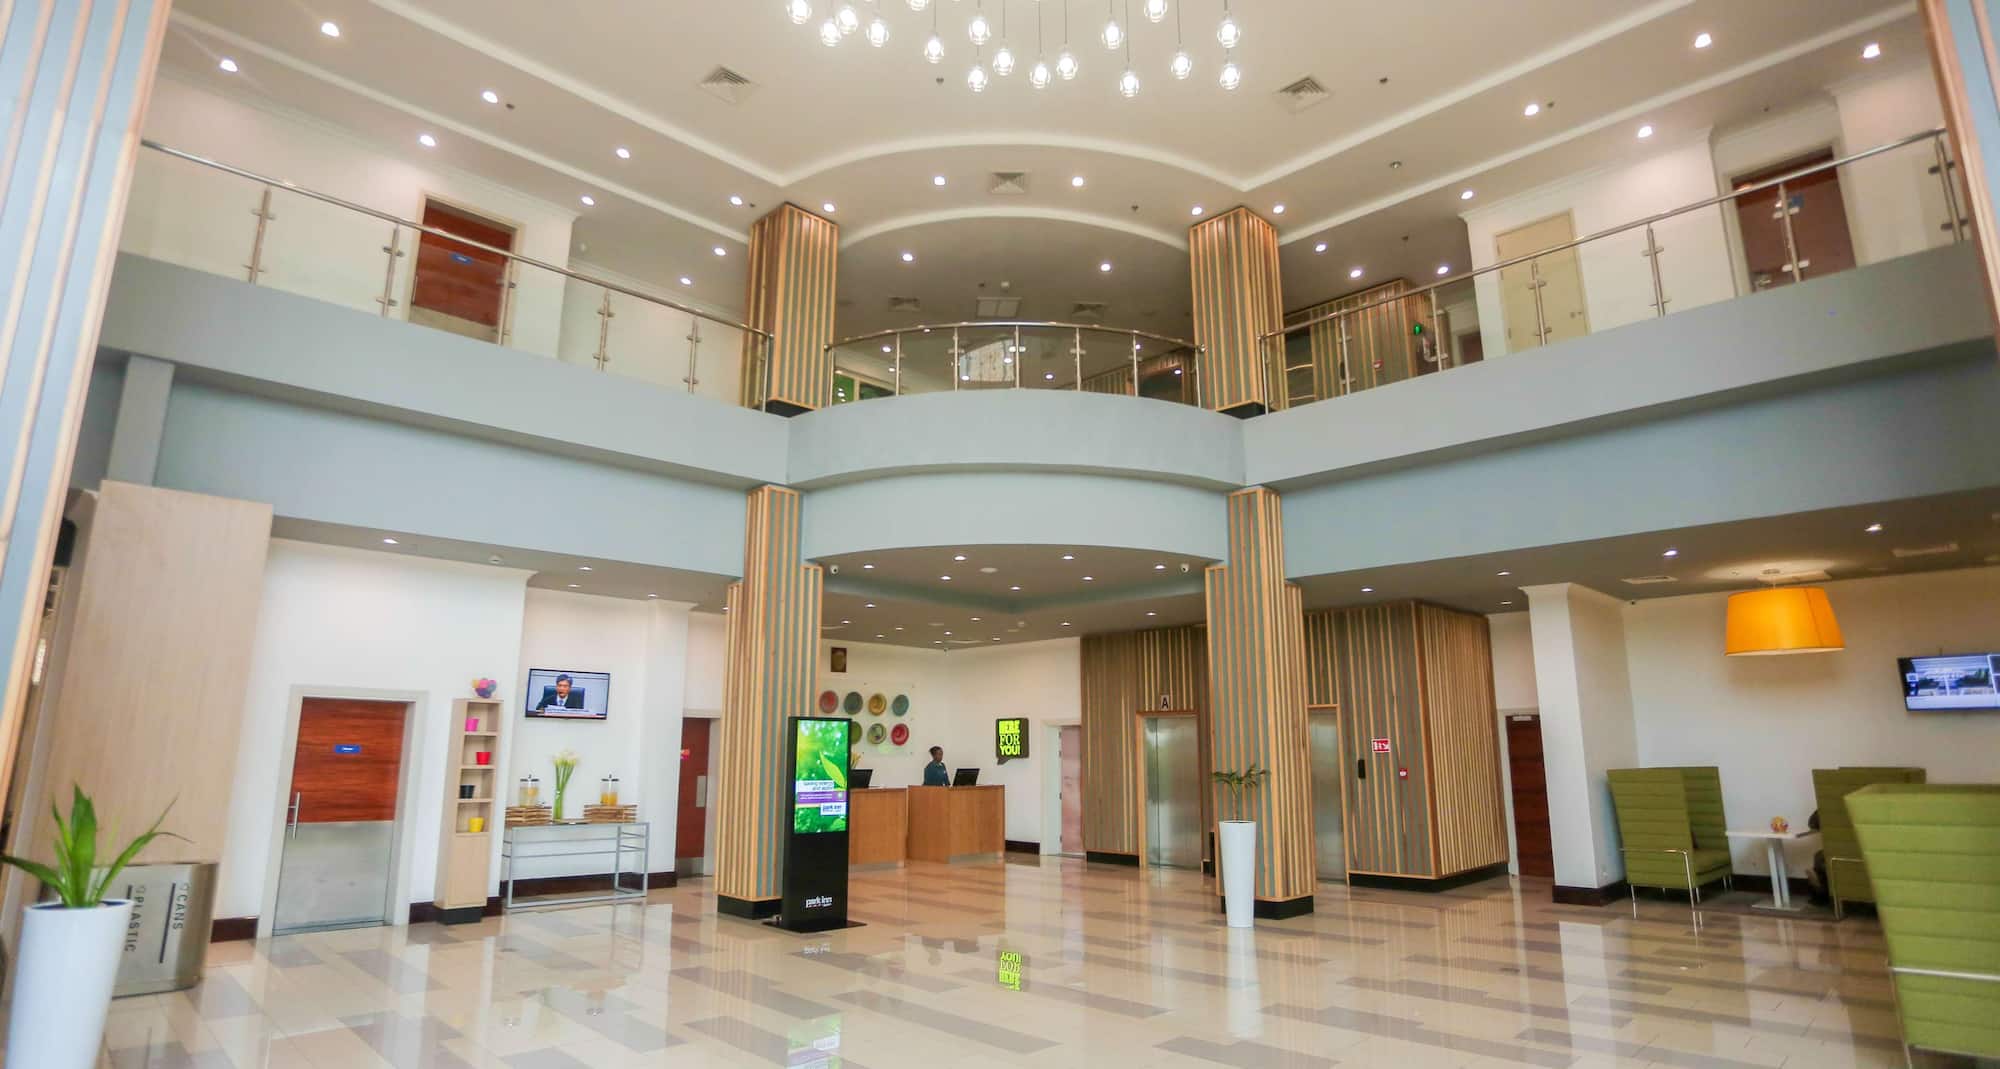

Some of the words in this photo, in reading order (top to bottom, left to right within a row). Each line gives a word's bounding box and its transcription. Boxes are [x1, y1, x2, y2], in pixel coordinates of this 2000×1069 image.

[1161, 697, 1169, 709] A
[999, 720, 1020, 734] HERE
[1000, 734, 1020, 745] FOR
[1000, 745, 1020, 756] YOU!
[172, 894, 188, 930] CANS
[123, 896, 145, 952] PLASTIC
